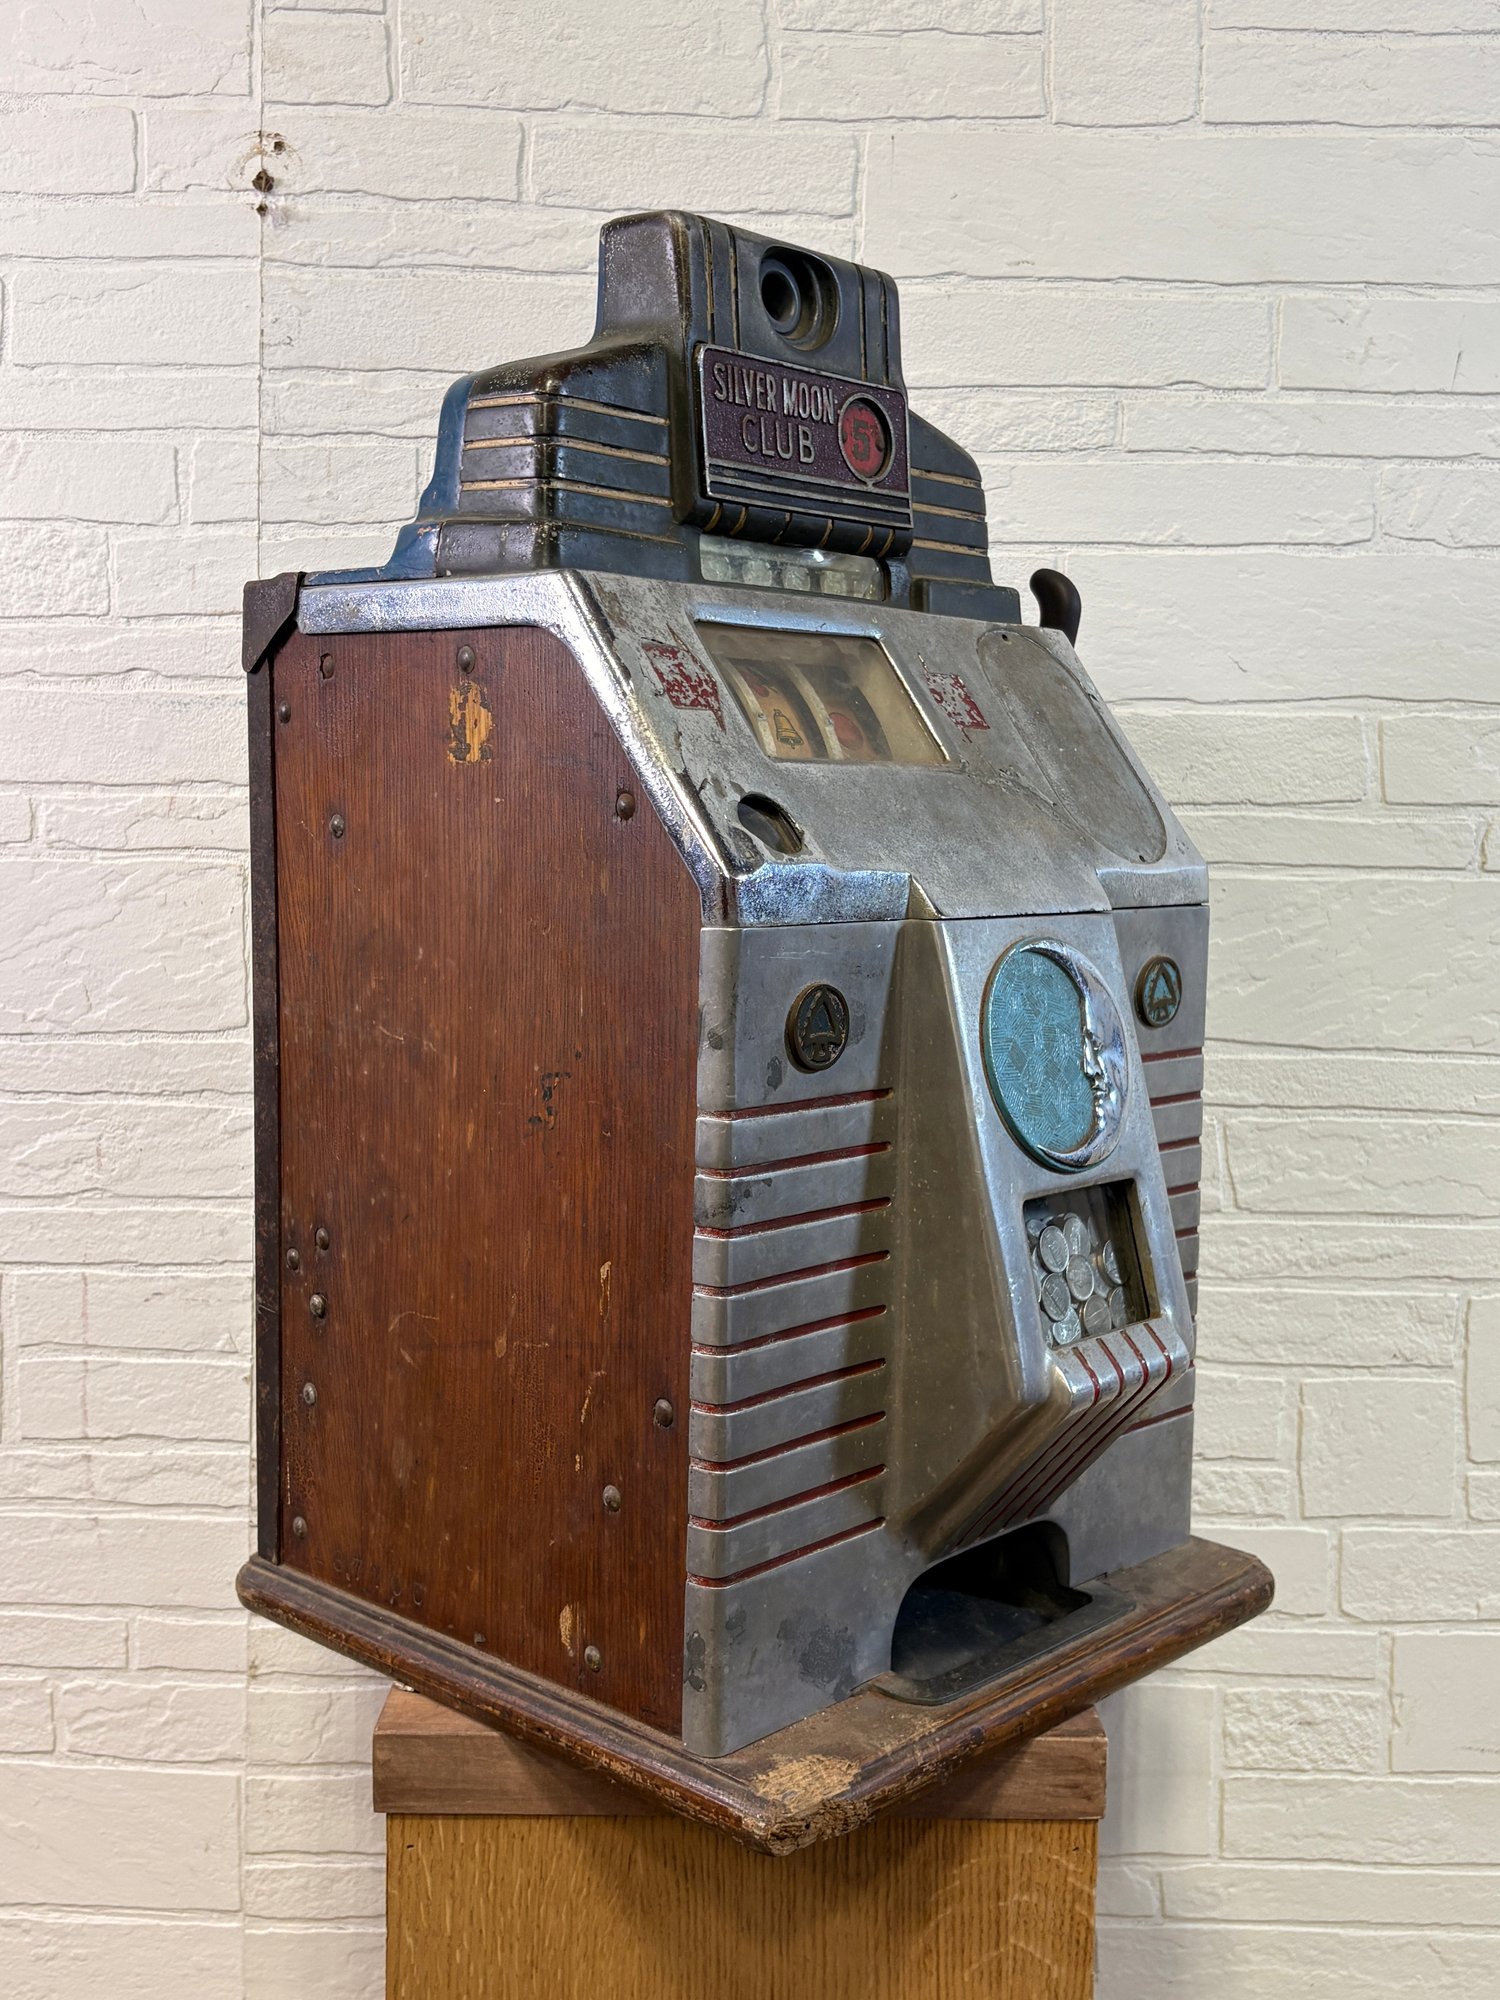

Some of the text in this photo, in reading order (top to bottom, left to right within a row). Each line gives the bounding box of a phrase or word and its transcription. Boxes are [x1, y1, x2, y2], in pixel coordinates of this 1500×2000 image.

[713, 362, 834, 424] SILVER MOON
[742, 414, 815, 464] CLUB
